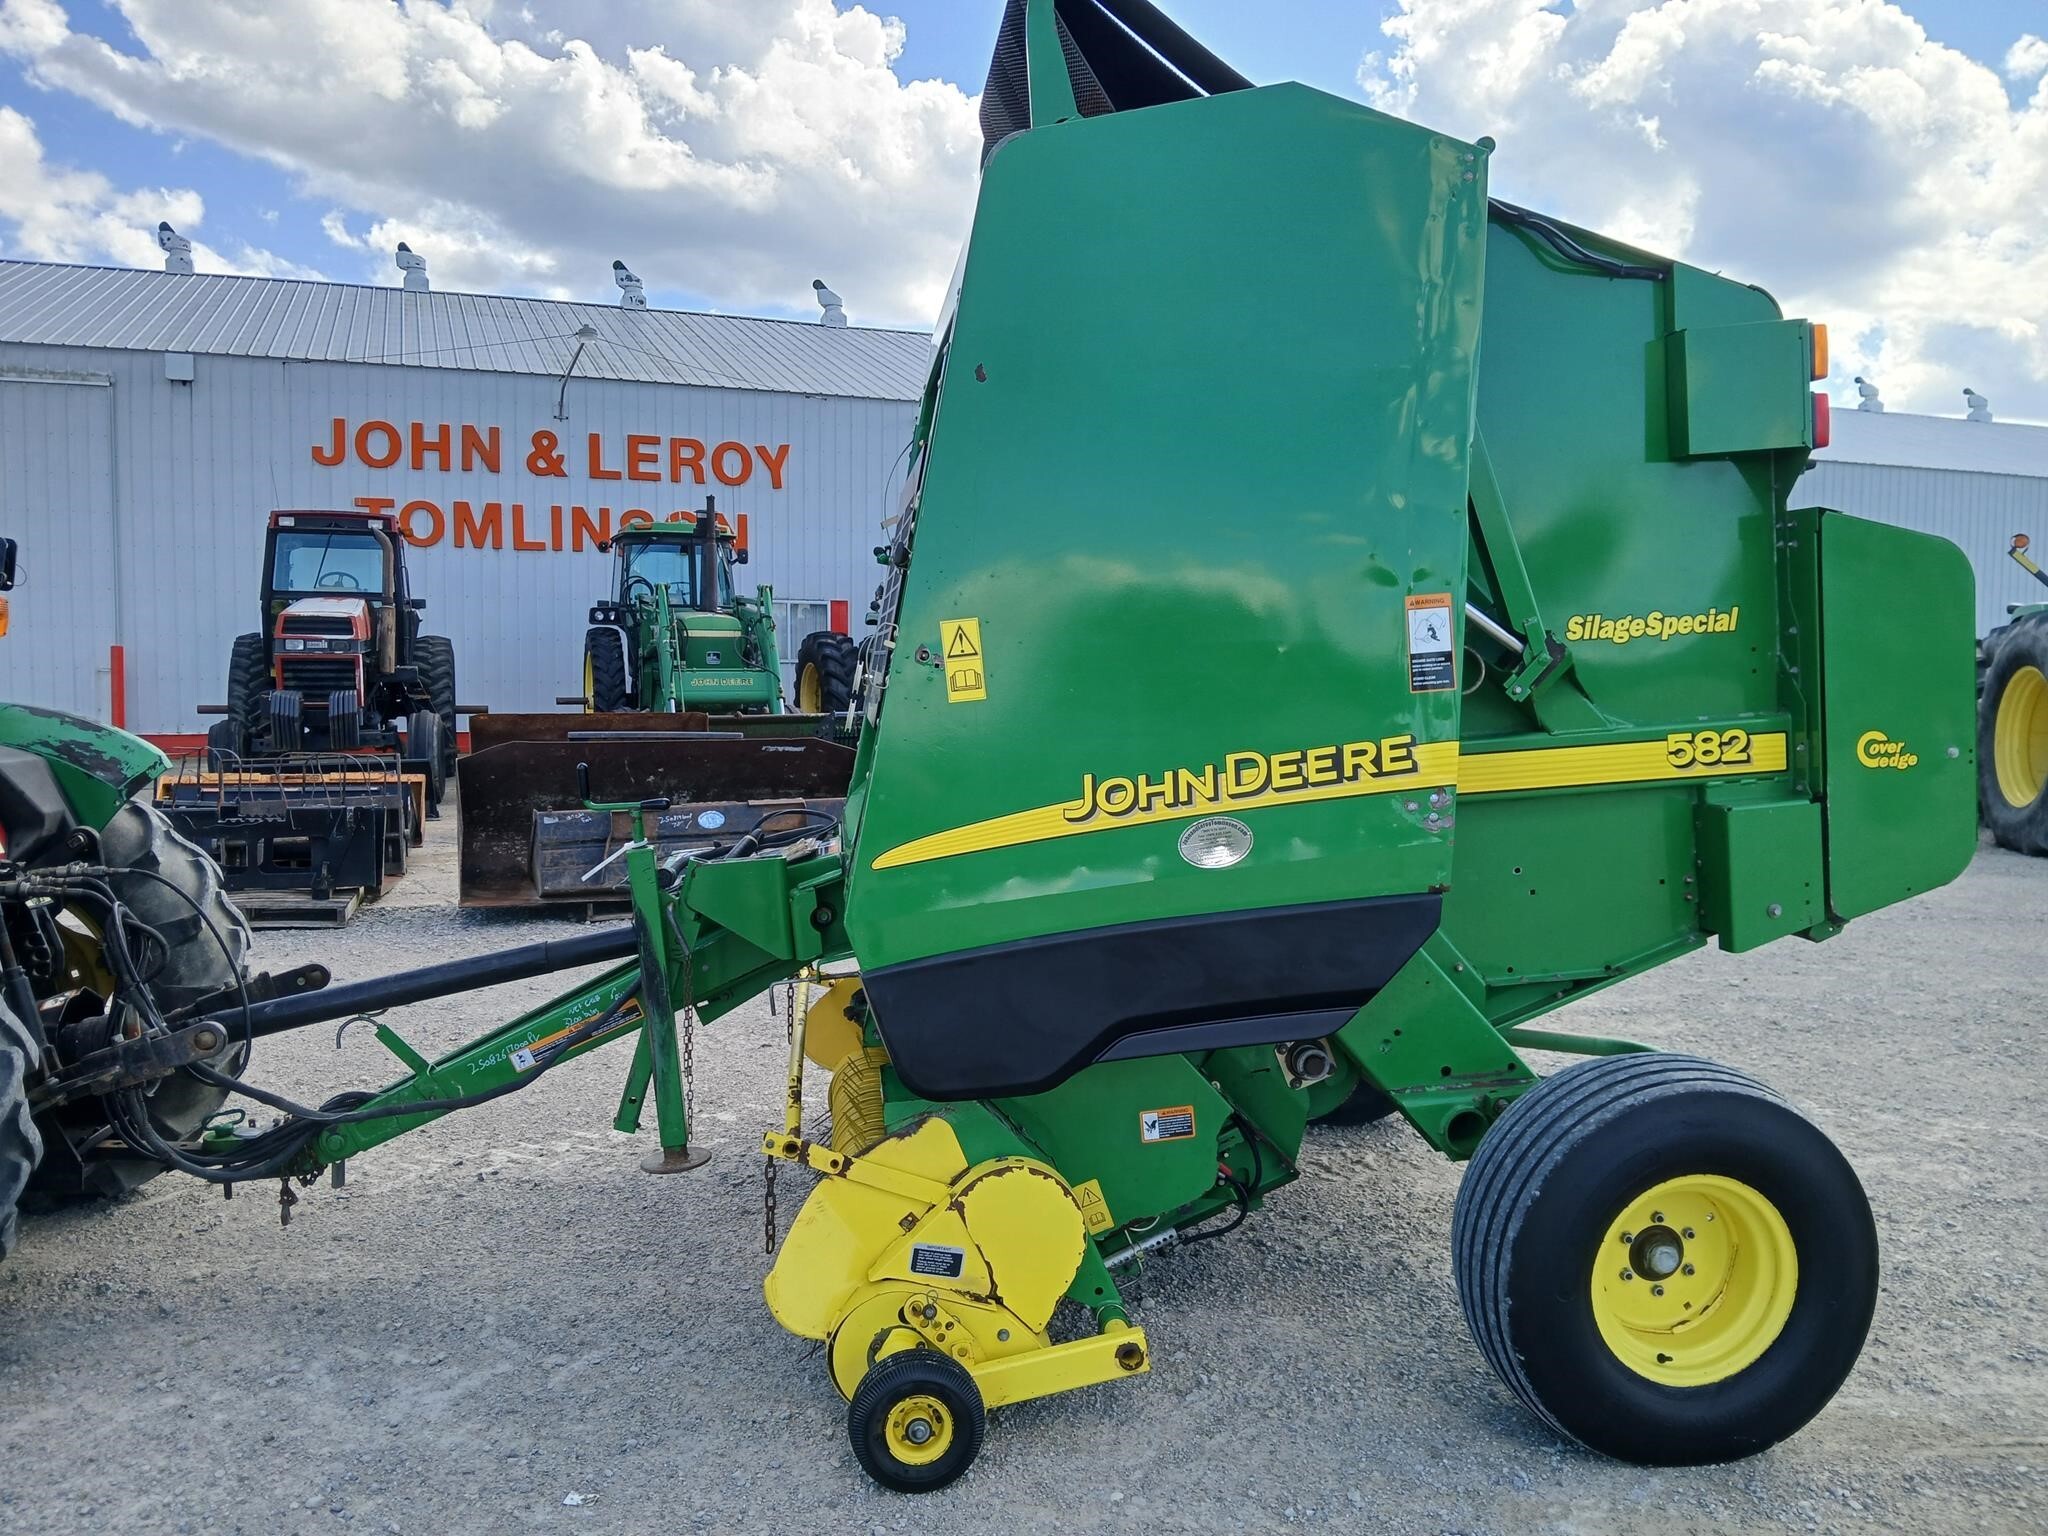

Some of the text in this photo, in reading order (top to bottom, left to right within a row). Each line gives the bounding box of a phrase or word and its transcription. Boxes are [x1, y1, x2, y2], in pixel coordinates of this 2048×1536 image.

[311, 417, 791, 489] JOHN & LEROY
[691, 677, 754, 687] JOHN DEERE
[1667, 728, 1751, 768] 582
[1063, 734, 1420, 823] JOHN DEERE
